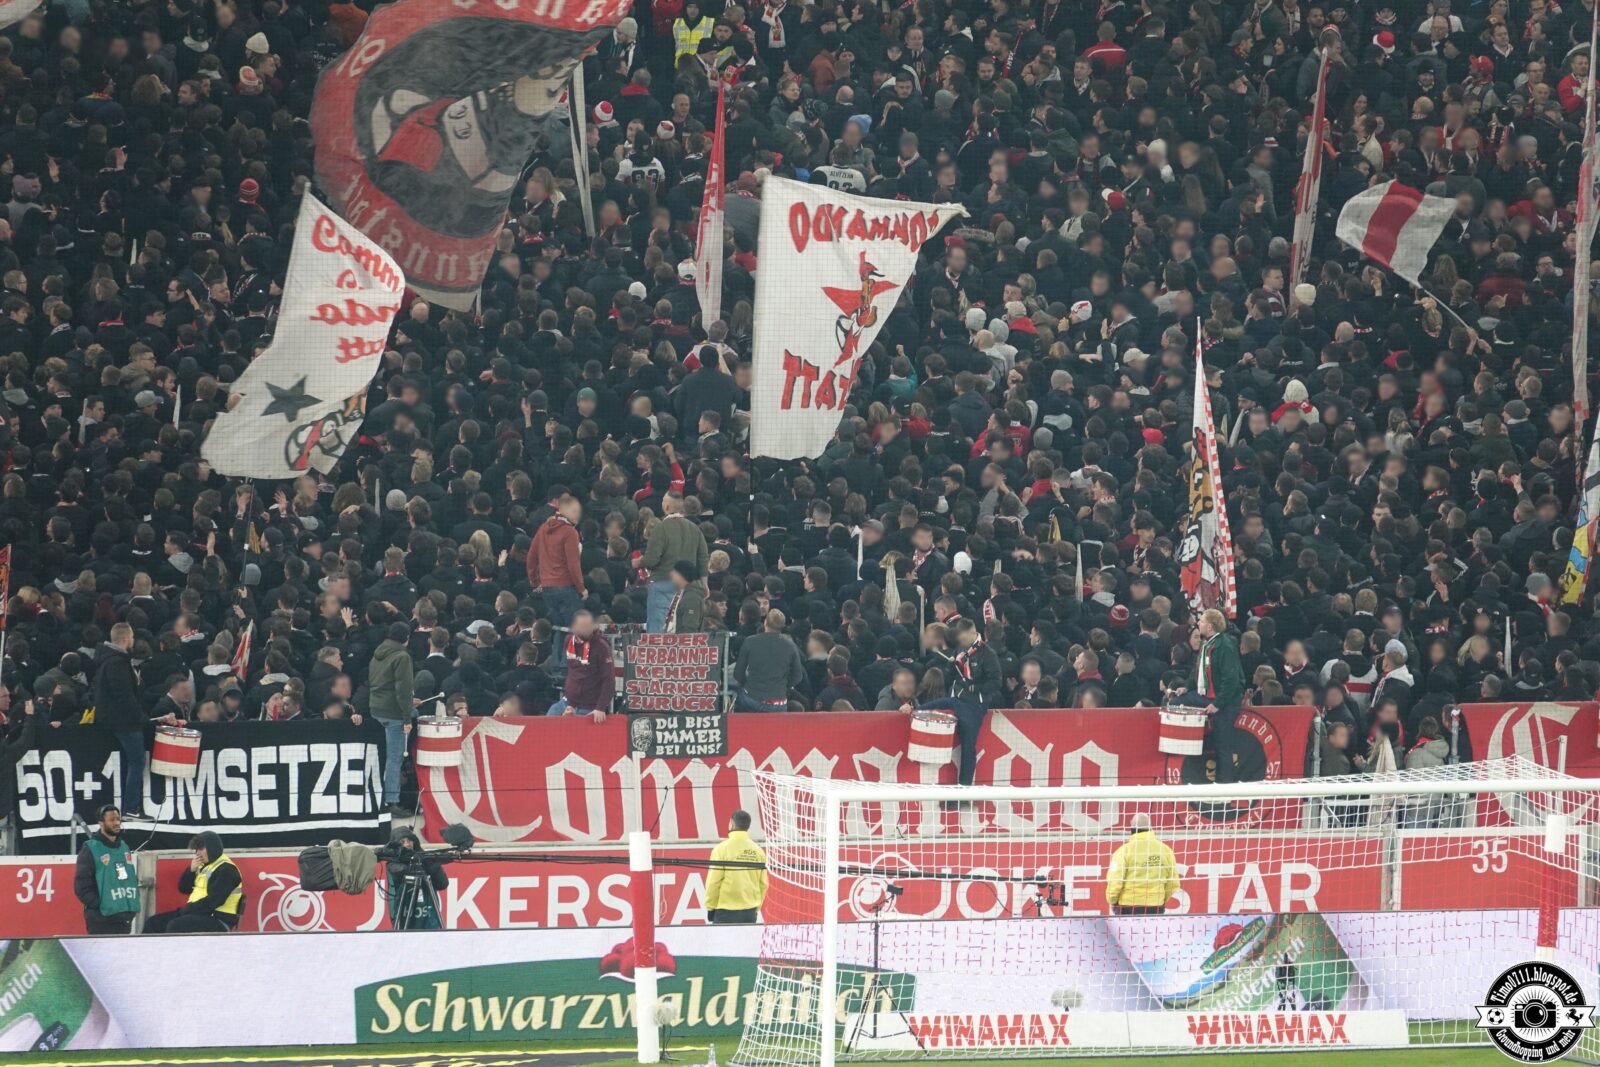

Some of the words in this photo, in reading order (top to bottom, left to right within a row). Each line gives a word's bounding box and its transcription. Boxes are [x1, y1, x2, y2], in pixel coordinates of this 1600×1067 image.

[637, 632, 709, 647] JEDER
[627, 645, 719, 665] VERBANNTE
[635, 664, 710, 680] KEHRT
[656, 717, 679, 730] DU
[685, 715, 721, 729] BIST
[656, 729, 721, 744] IMMER
[656, 745, 680, 755] BEI
[686, 743, 722, 754] UNS!
[16, 749, 122, 822] 50+1
[143, 742, 383, 821] UMSETZEN
[1472, 839, 1509, 874] 35
[15, 868, 55, 903] 34
[111, 887, 137, 901] HOST
[922, 863, 1323, 918] JOKESTAR
[357, 872, 764, 930] JKERSTA
[909, 1014, 1071, 1047] WINAMAX
[1187, 1014, 1351, 1046] WINAMAX
